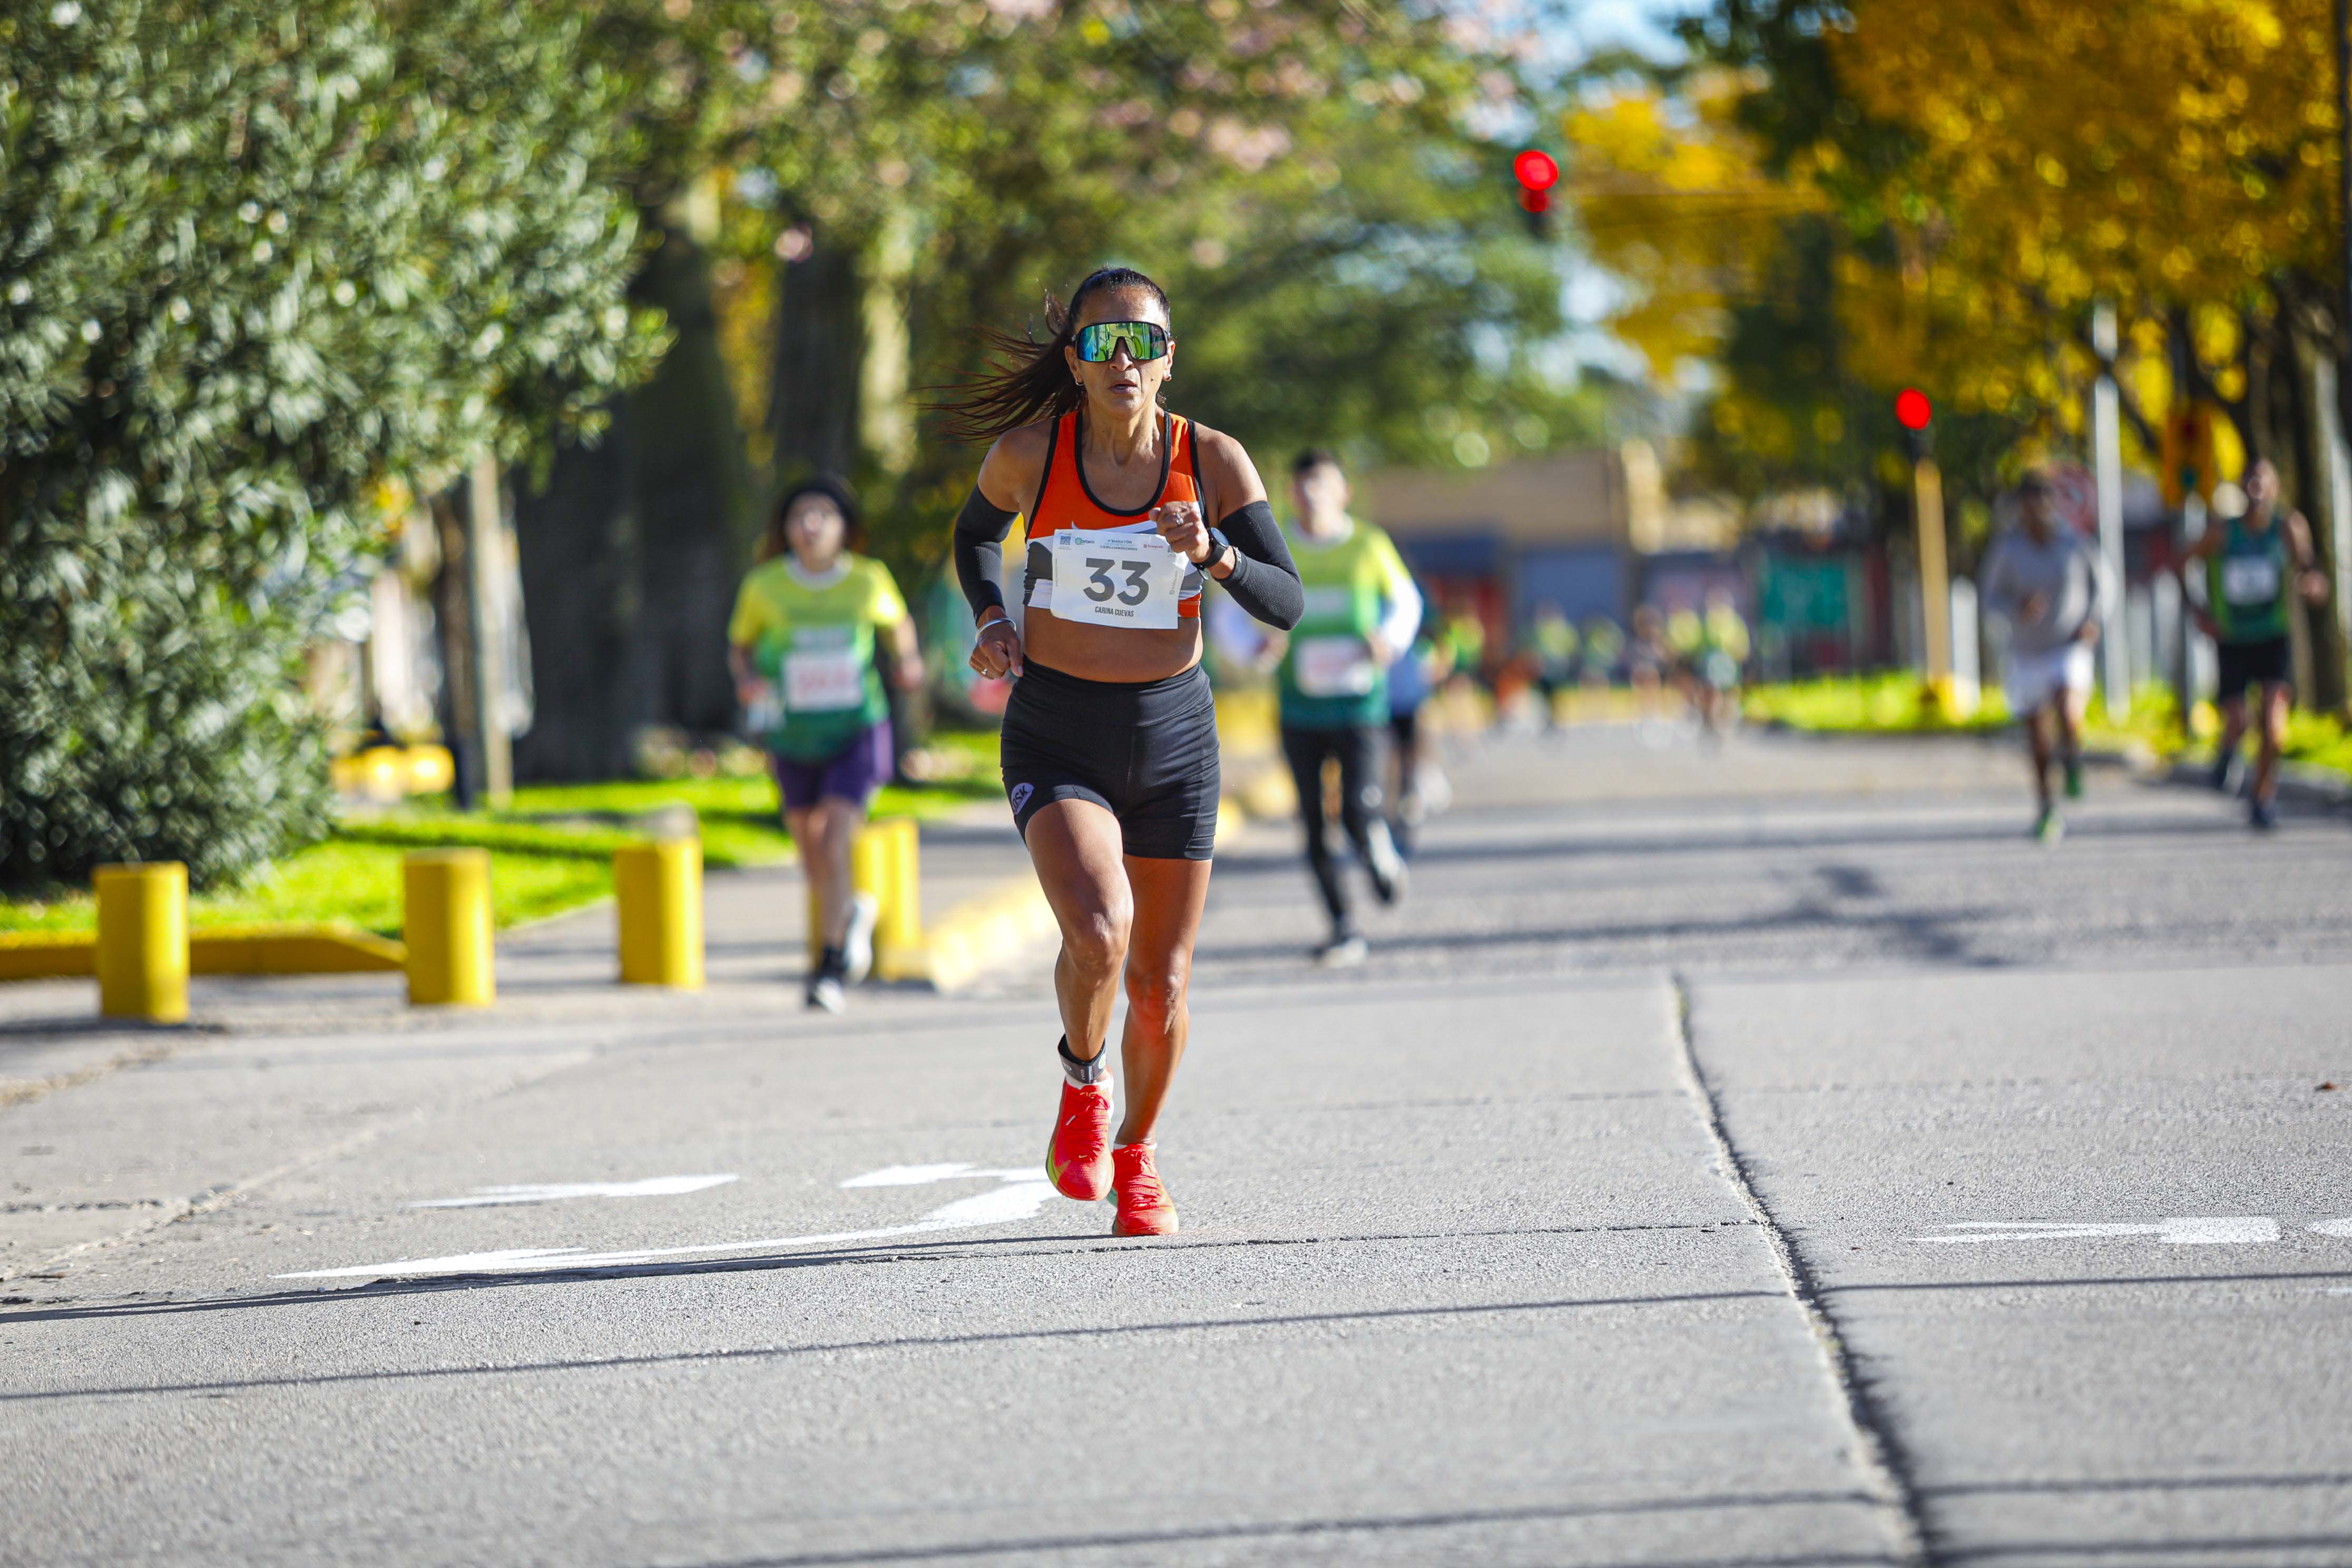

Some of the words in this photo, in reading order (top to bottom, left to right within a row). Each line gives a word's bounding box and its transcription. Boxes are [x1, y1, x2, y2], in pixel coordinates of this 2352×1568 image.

[1083, 557, 1151, 606] 33
[1095, 606, 1114, 615] CARINA
[1114, 609, 1134, 617] CUEVAS
